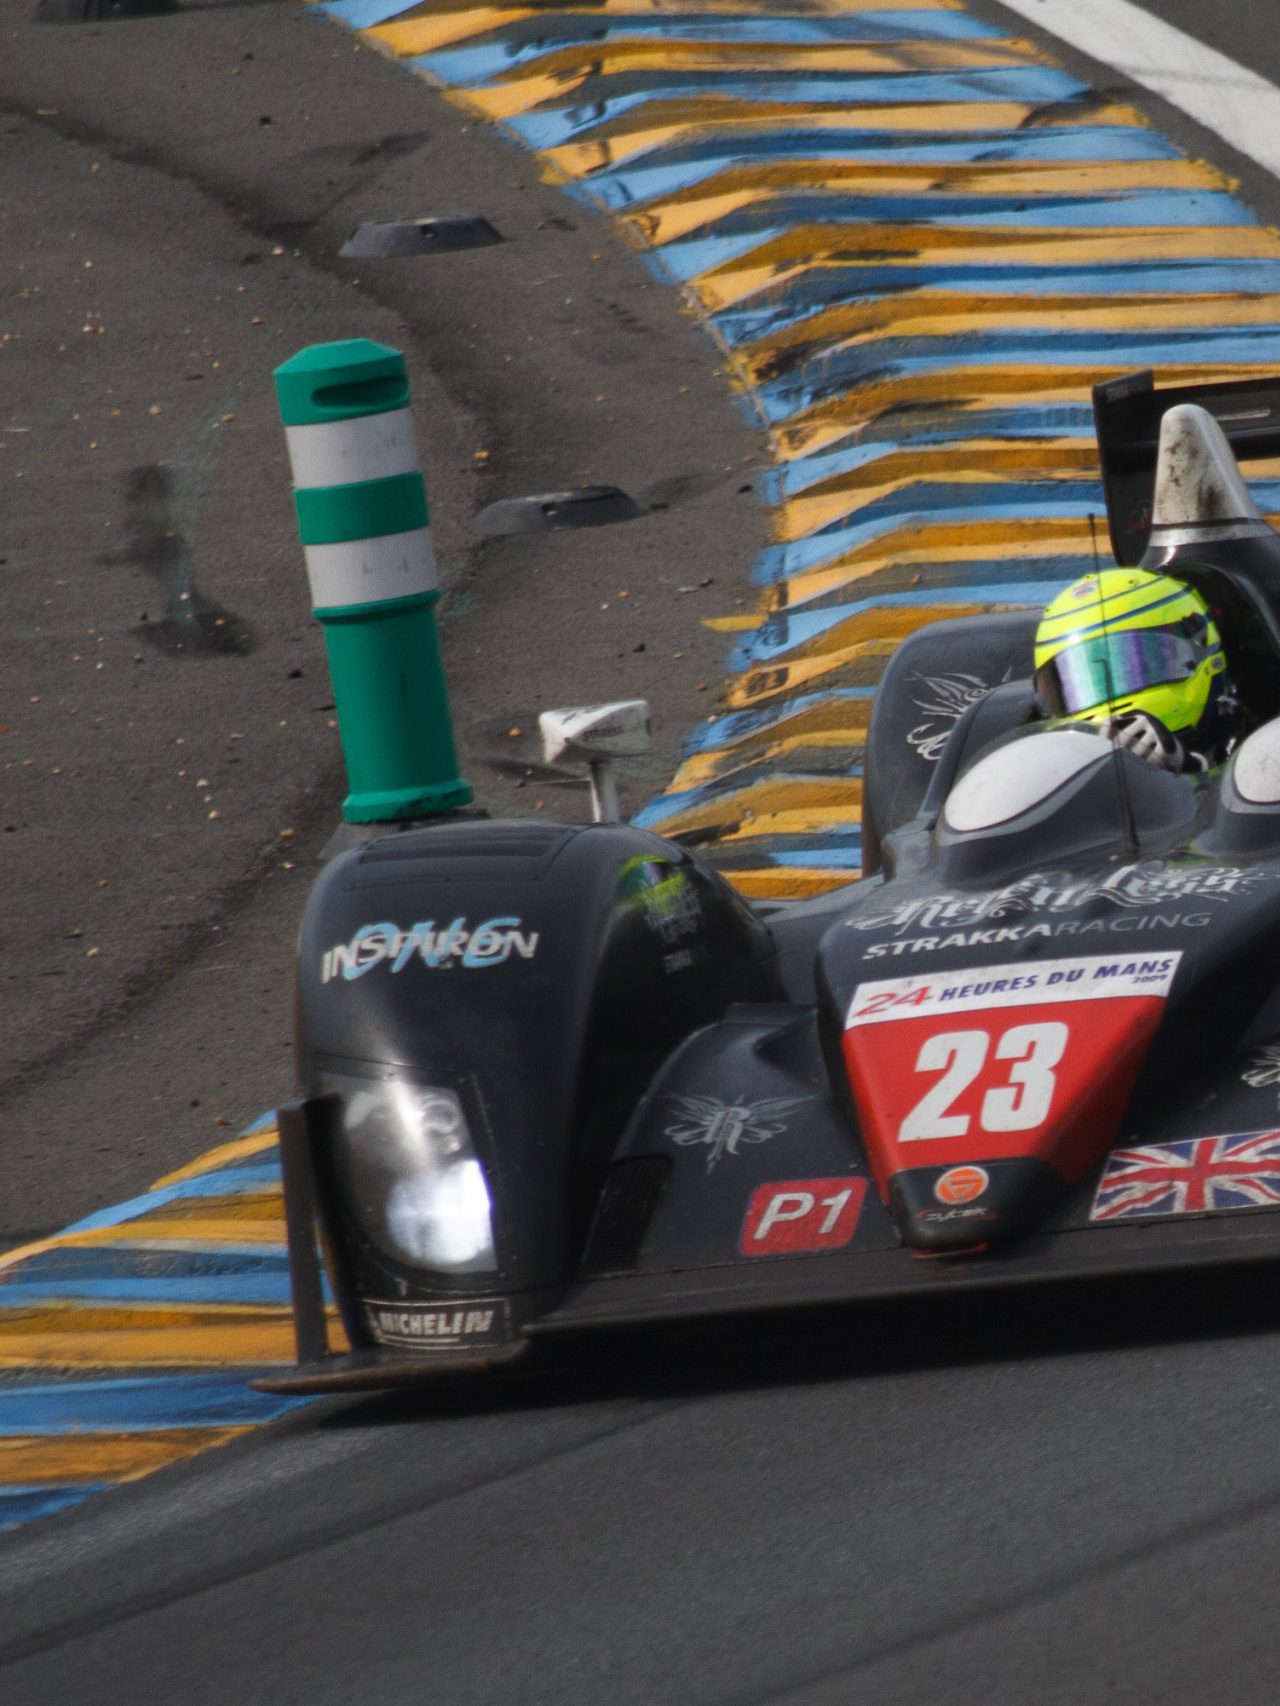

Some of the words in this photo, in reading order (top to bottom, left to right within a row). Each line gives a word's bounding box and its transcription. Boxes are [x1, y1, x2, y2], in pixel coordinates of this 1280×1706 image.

[852, 986, 934, 1018] 24
[939, 973, 1037, 1002] HEURES
[1045, 968, 1084, 986] DU
[1091, 958, 1175, 980] MANS
[1130, 973, 1168, 985] 2009
[897, 1021, 1069, 1143] 23
[753, 1189, 854, 1241] P1
[379, 1310, 495, 1336] MICHELIN
